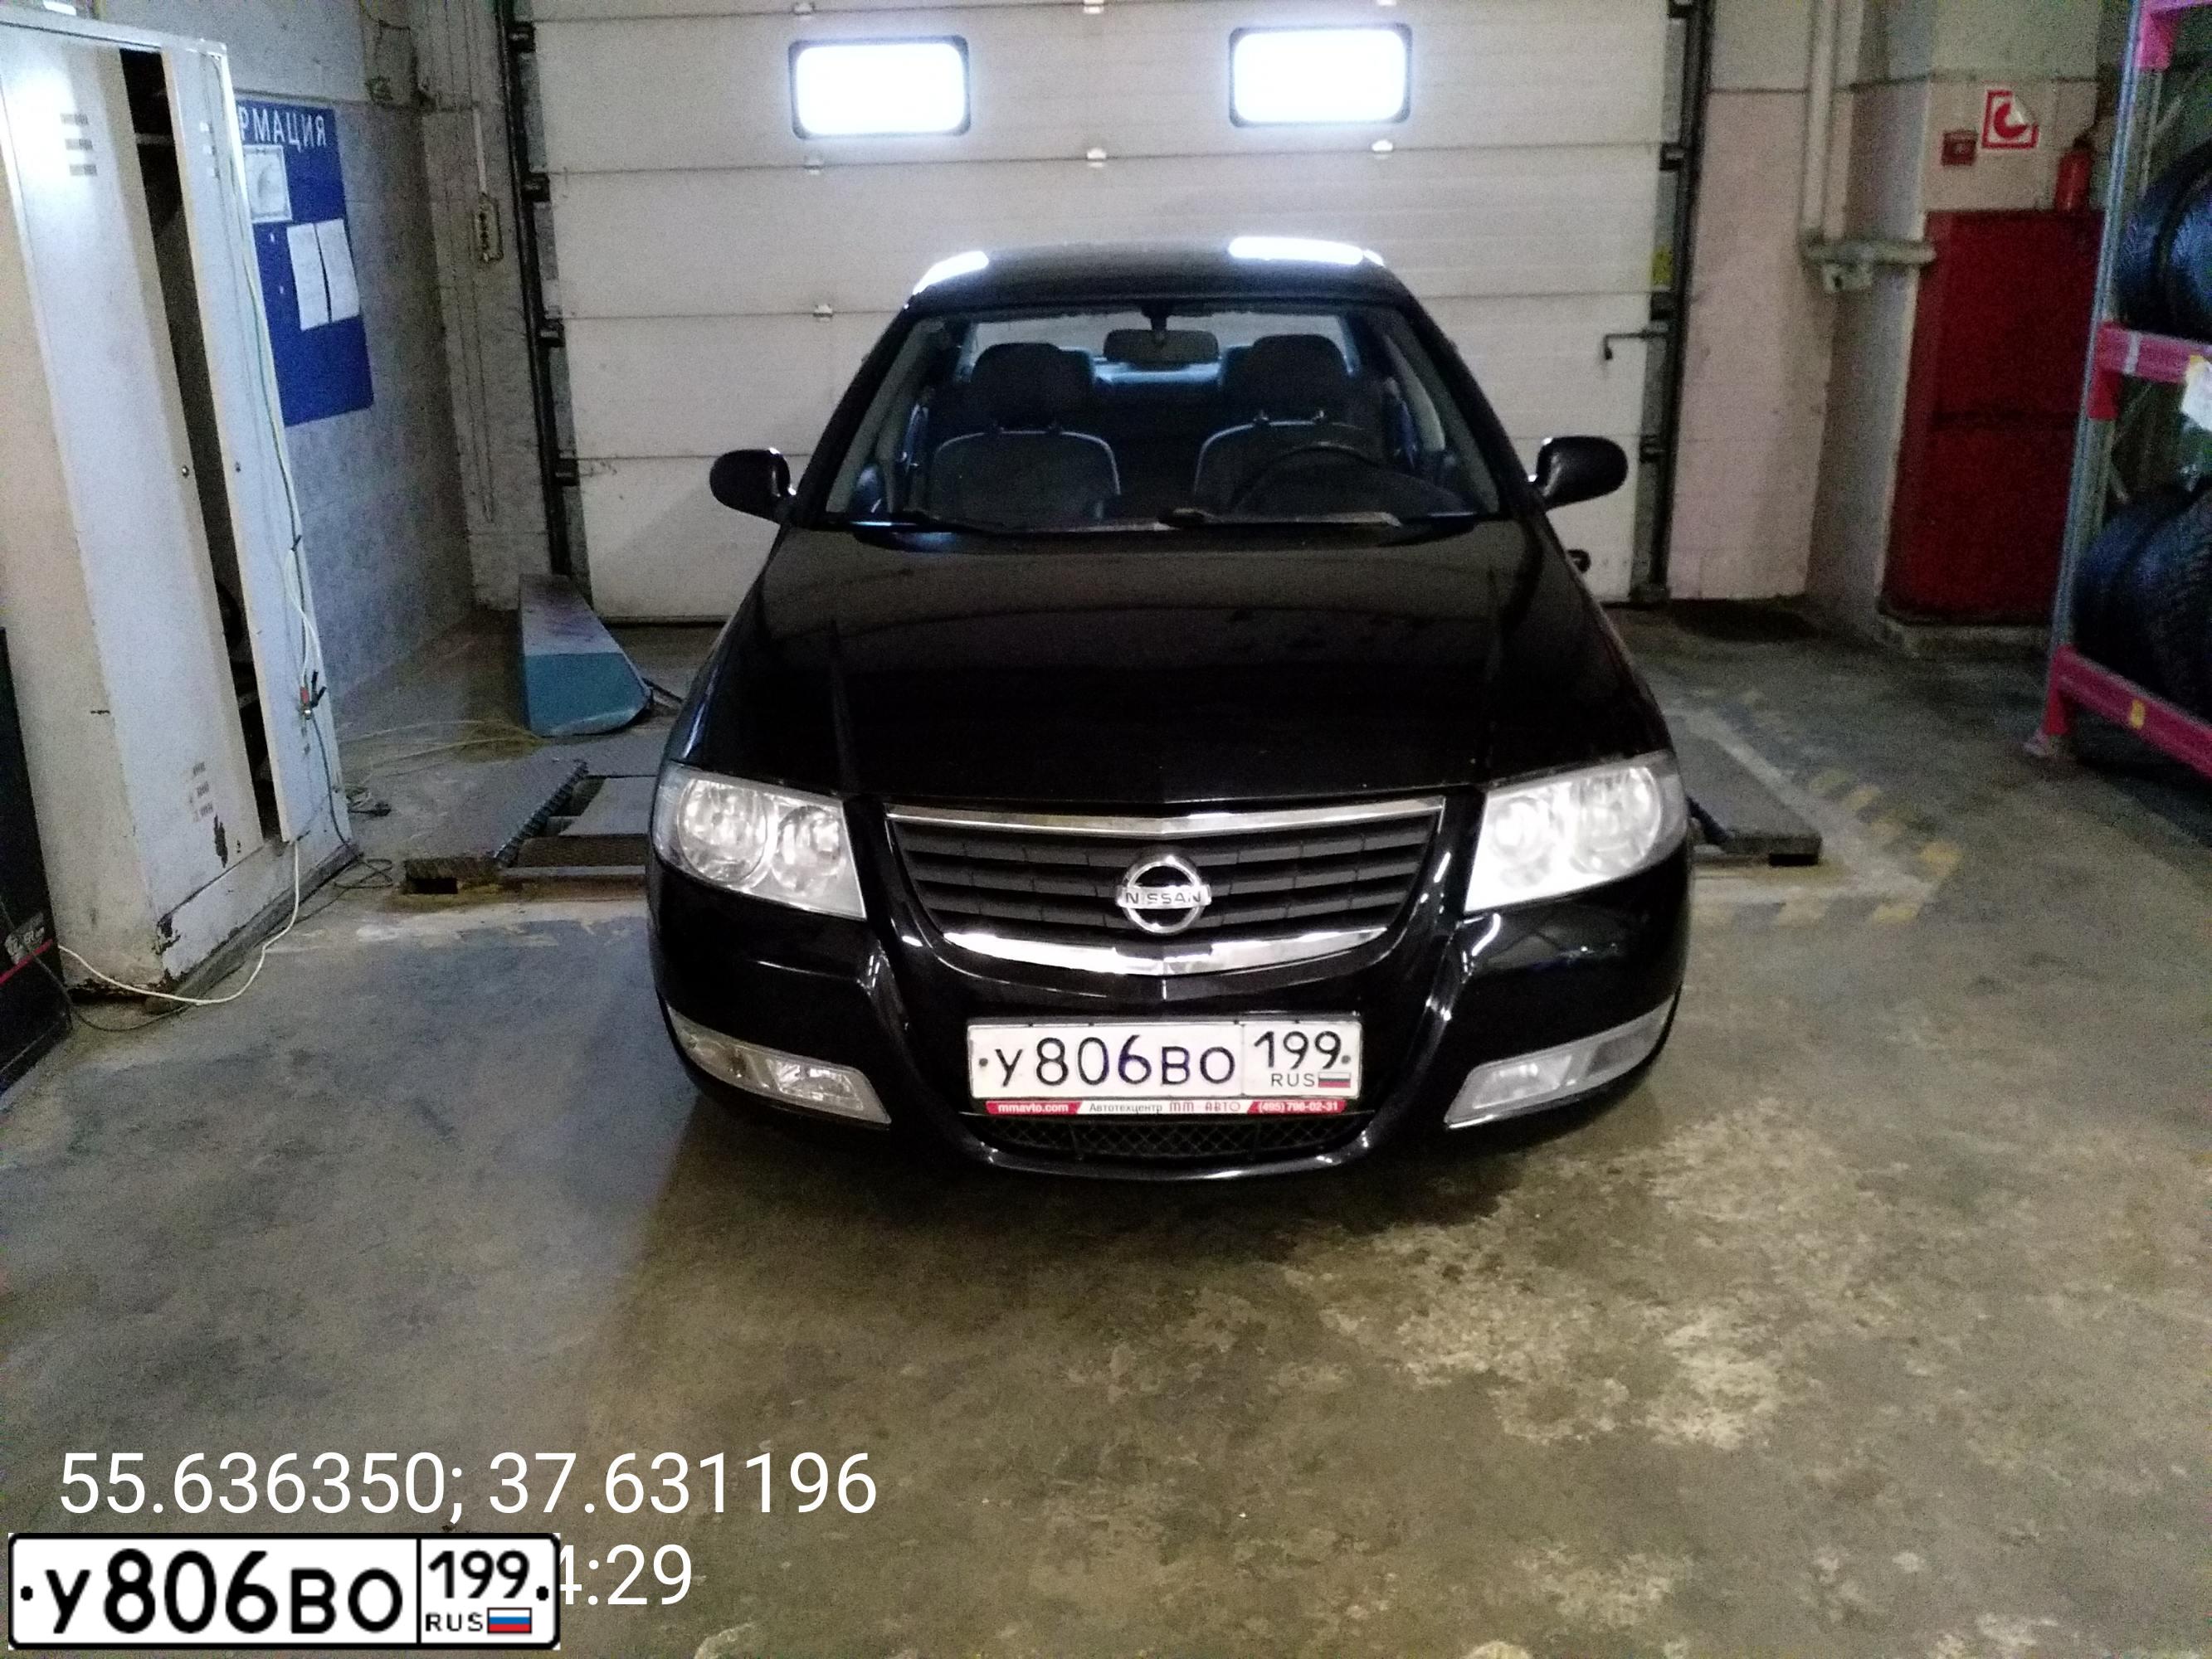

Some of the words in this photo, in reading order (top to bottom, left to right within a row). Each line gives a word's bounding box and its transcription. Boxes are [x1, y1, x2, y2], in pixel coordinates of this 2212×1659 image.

[237, 105, 326, 153] РМАЦИЯ
[1125, 891, 1202, 905] NISSAN
[995, 1034, 1235, 1087] У806ВО
[1254, 1030, 1342, 1069] 199
[1270, 1073, 1315, 1087] RUS
[998, 1102, 1069, 1113] mmavto.com
[1089, 1102, 1162, 1115] Автотехцентр
[1258, 1101, 1286, 1113] (495)
